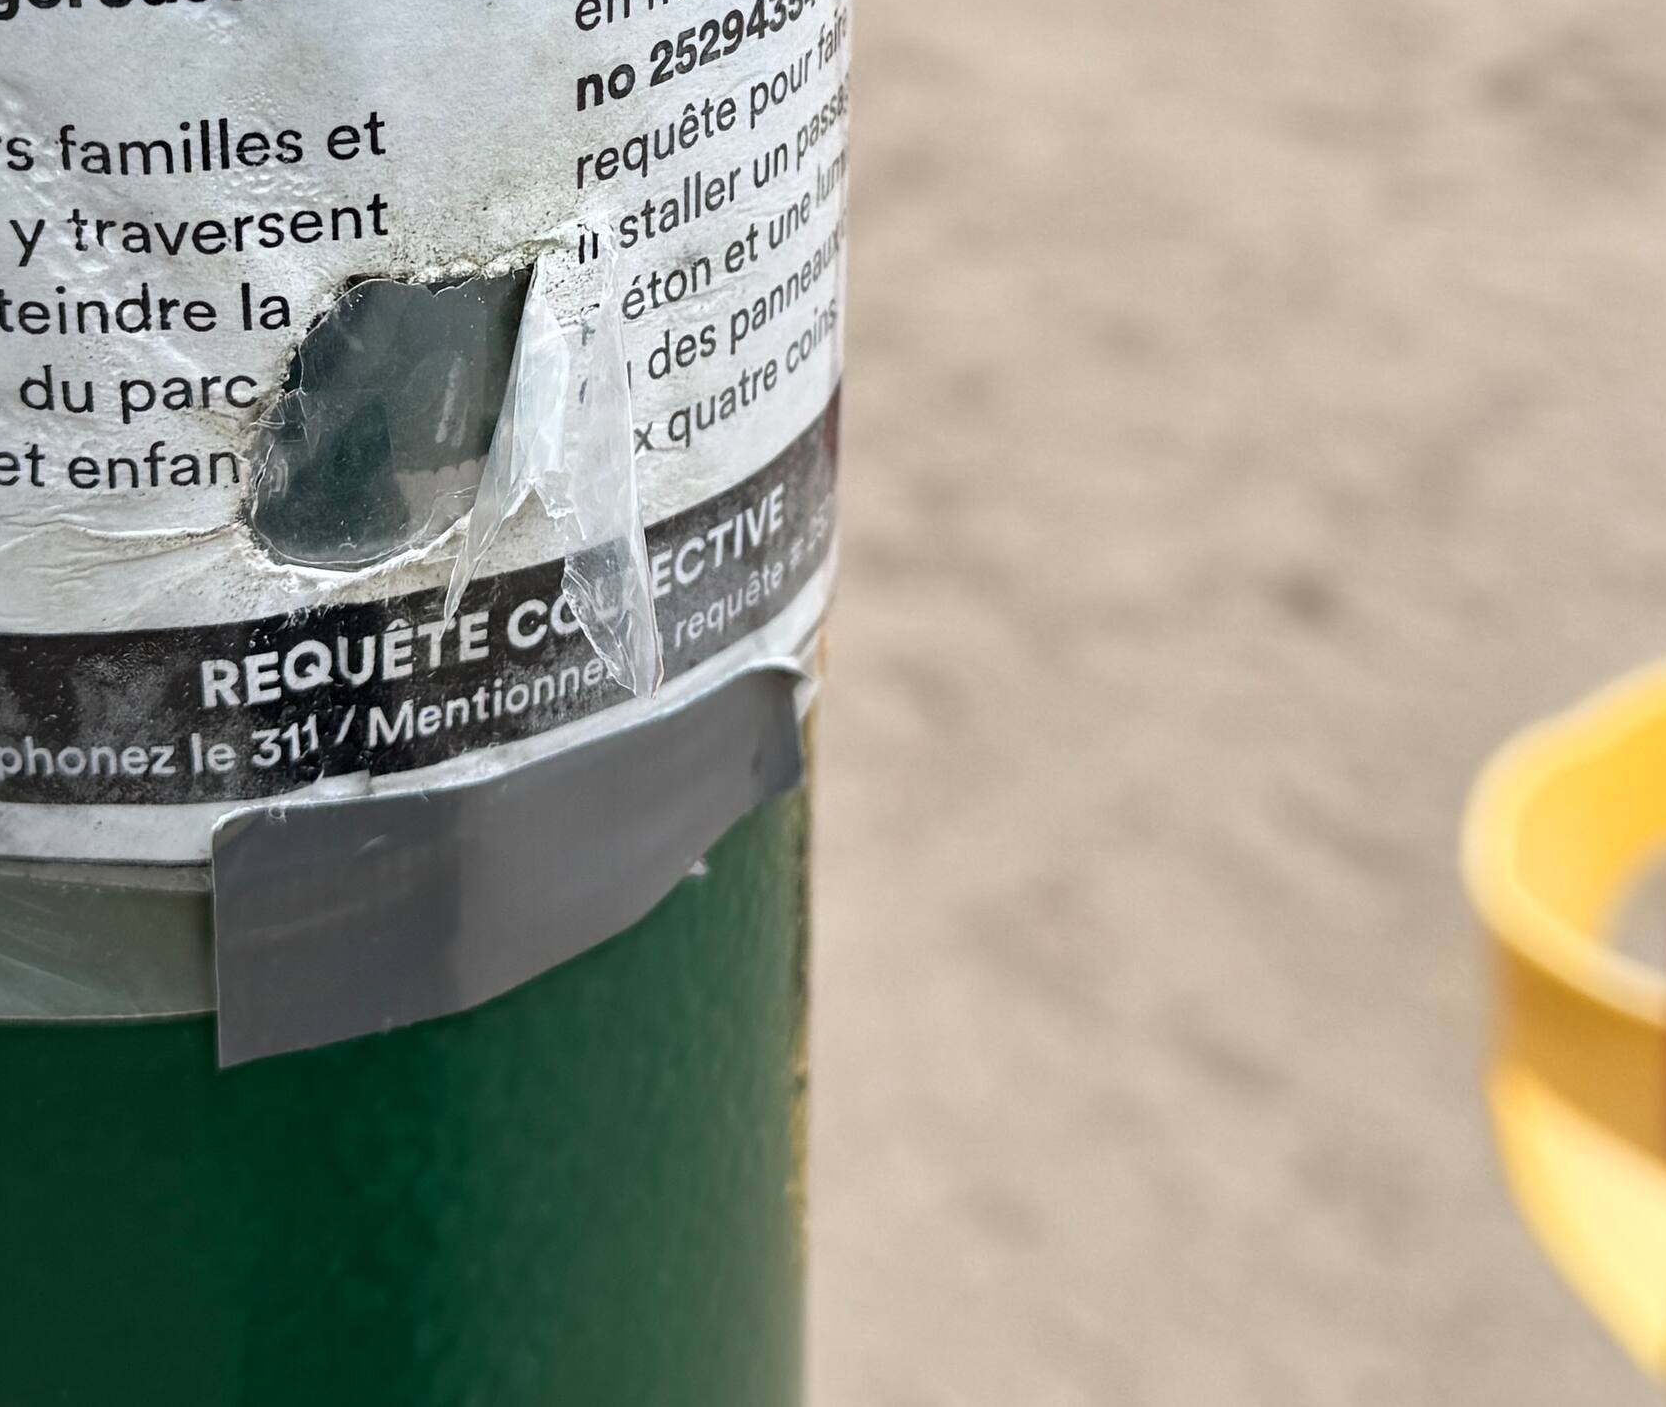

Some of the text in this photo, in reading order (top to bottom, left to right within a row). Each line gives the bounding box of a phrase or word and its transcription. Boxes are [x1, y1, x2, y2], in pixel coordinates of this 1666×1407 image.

[576, 62, 636, 112] no
[576, 93, 737, 190] requête
[749, 49, 813, 130] pour
[57, 117, 305, 177] familles
[325, 110, 387, 163] et
[752, 141, 789, 191] un
[12, 215, 46, 267] y
[73, 193, 389, 257] traversent
[724, 223, 760, 275] et
[768, 190, 811, 251] une
[240, 281, 292, 333] la
[647, 324, 717, 382] des
[667, 357, 779, 450] quatre
[786, 298, 837, 374] coins
[20, 363, 95, 415] du
[120, 373, 259, 426] parc
[66, 439, 242, 491] enfan
[191, 732, 236, 776] le
[251, 712, 320, 771] 311
[367, 657, 610, 750] Mentionne
[674, 557, 785, 649] requête
[199, 610, 490, 710] REQUÊTE
